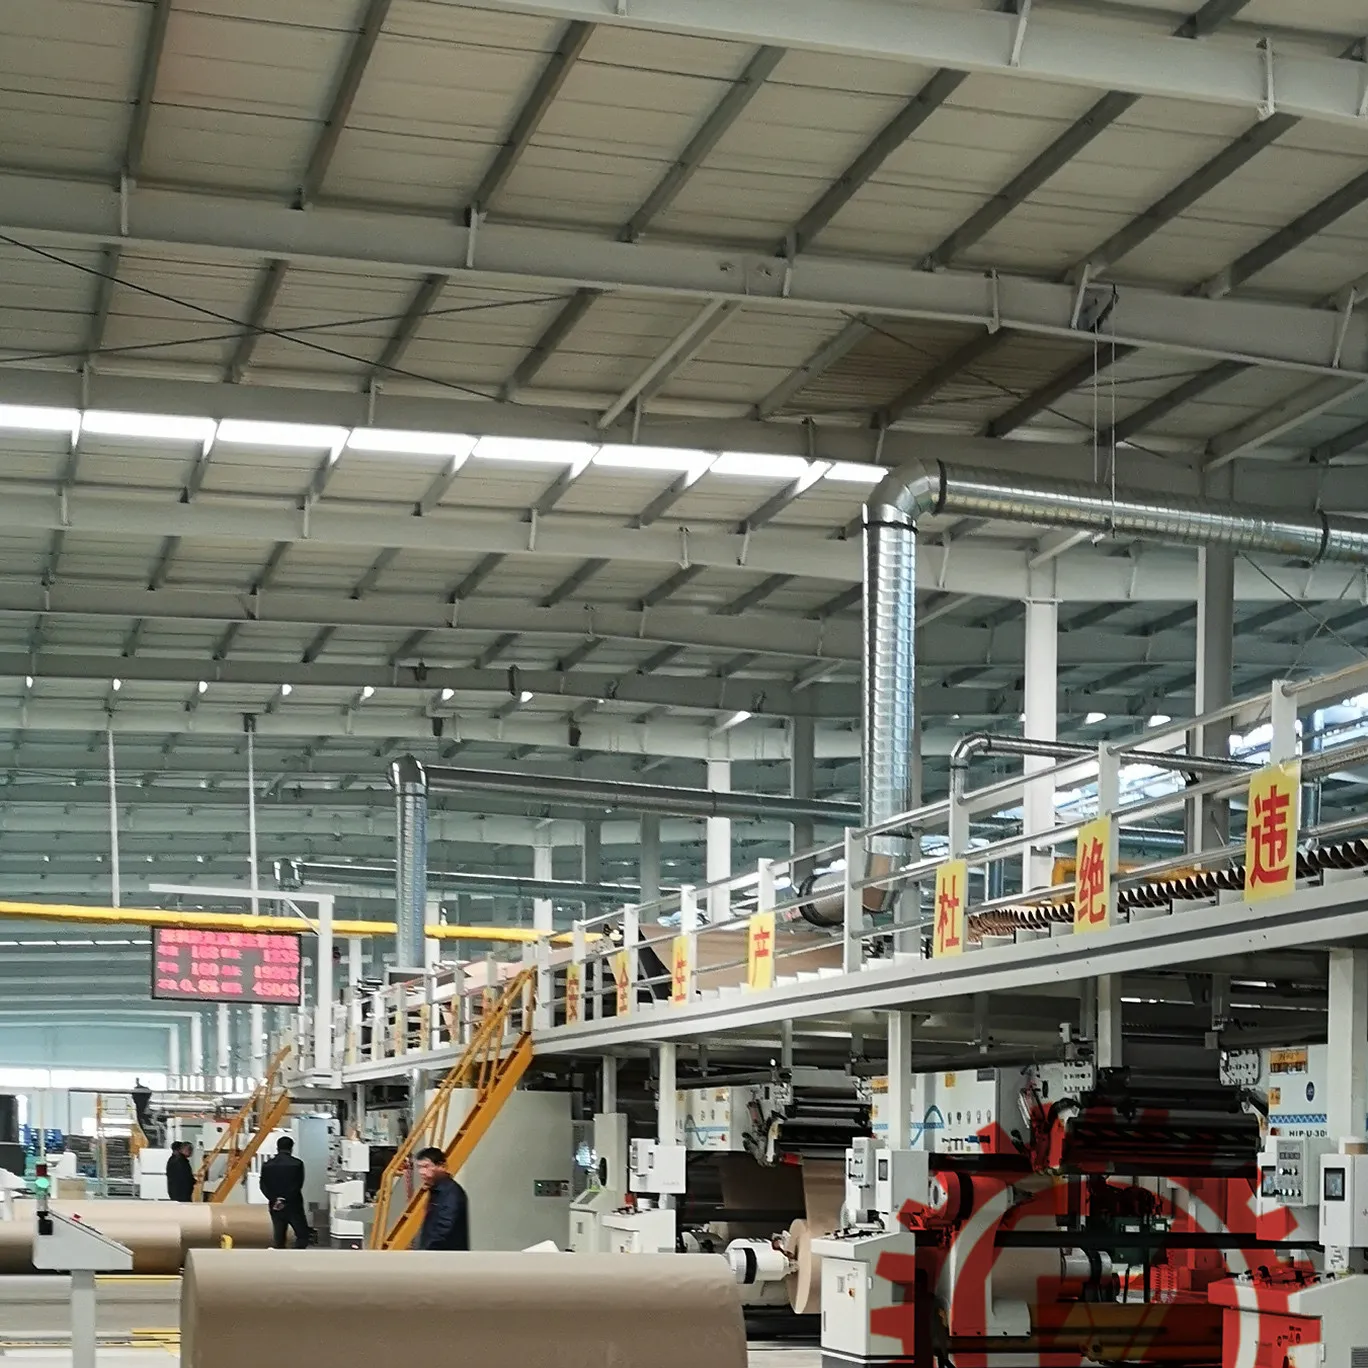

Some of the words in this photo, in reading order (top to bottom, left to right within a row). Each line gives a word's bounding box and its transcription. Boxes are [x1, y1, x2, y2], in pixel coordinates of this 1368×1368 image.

[1250, 785, 1290, 887] 违
[937, 874, 960, 953] 杜
[1078, 837, 1106, 924] 绝
[752, 926, 771, 987] 产
